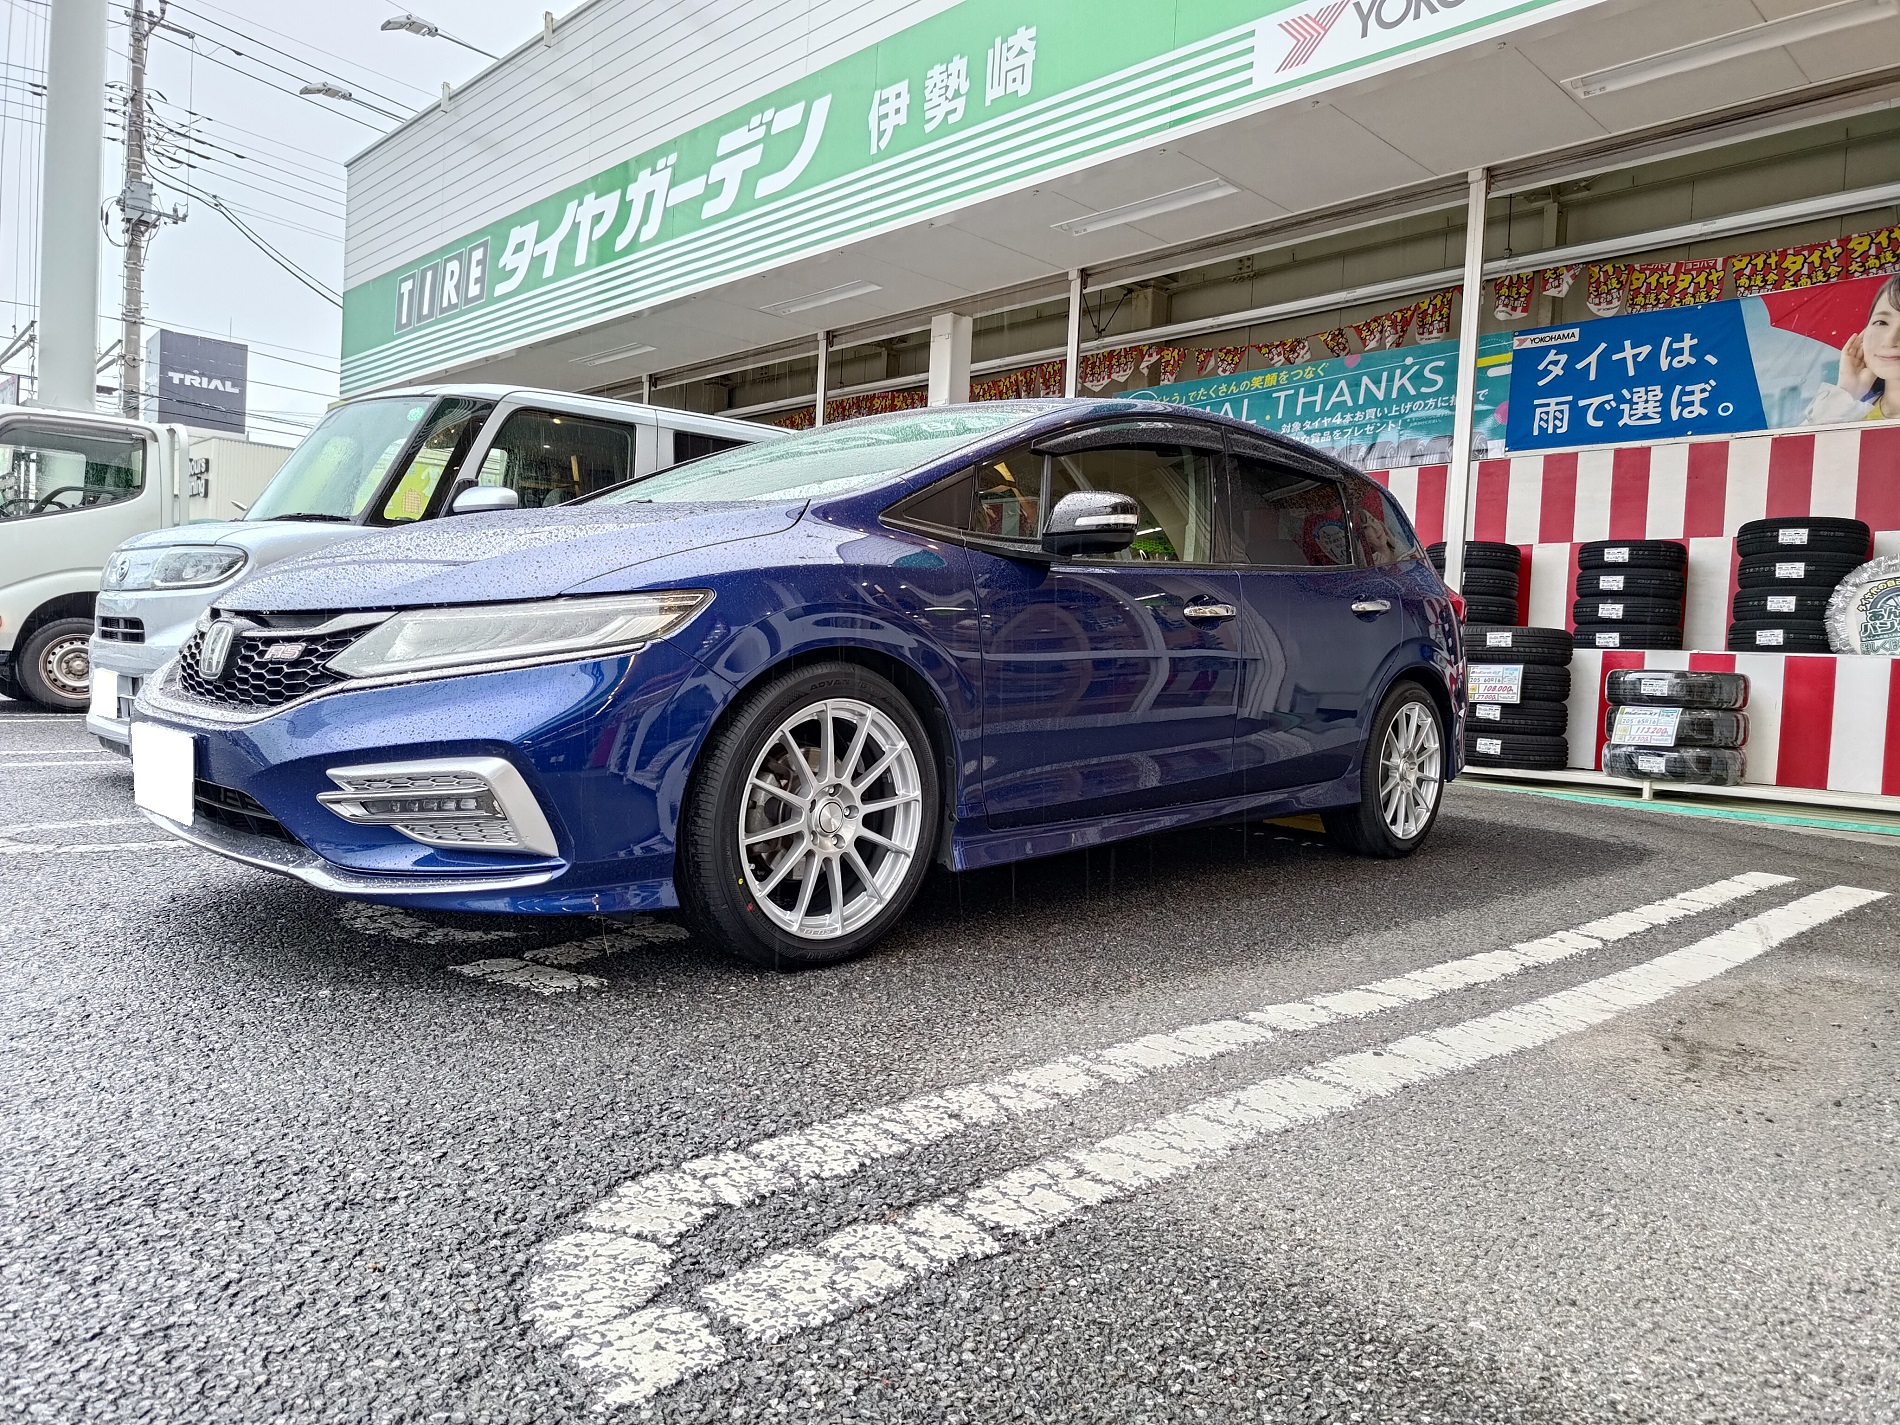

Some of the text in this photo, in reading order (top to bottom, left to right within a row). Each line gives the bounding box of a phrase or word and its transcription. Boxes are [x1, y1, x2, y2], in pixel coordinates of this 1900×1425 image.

[868, 25, 1037, 156] 伊勢崎
[494, 93, 832, 298] タイヤガーデン
[1685, 260, 1716, 270] ヨコハマ
[1781, 245, 1842, 277] タイヤ
[399, 245, 486, 325] TIRE
[1630, 271, 1676, 290] タイヤ
[1674, 269, 1725, 293] タイヤ
[1530, 331, 1576, 345] YOKOHAMA
[1537, 332, 1718, 387] タイヤは、
[168, 370, 240, 394] TRIAL
[1271, 360, 1446, 419] THANKS
[1532, 379, 1734, 436] 雨で選ぼ。
[264, 643, 305, 661] RS
